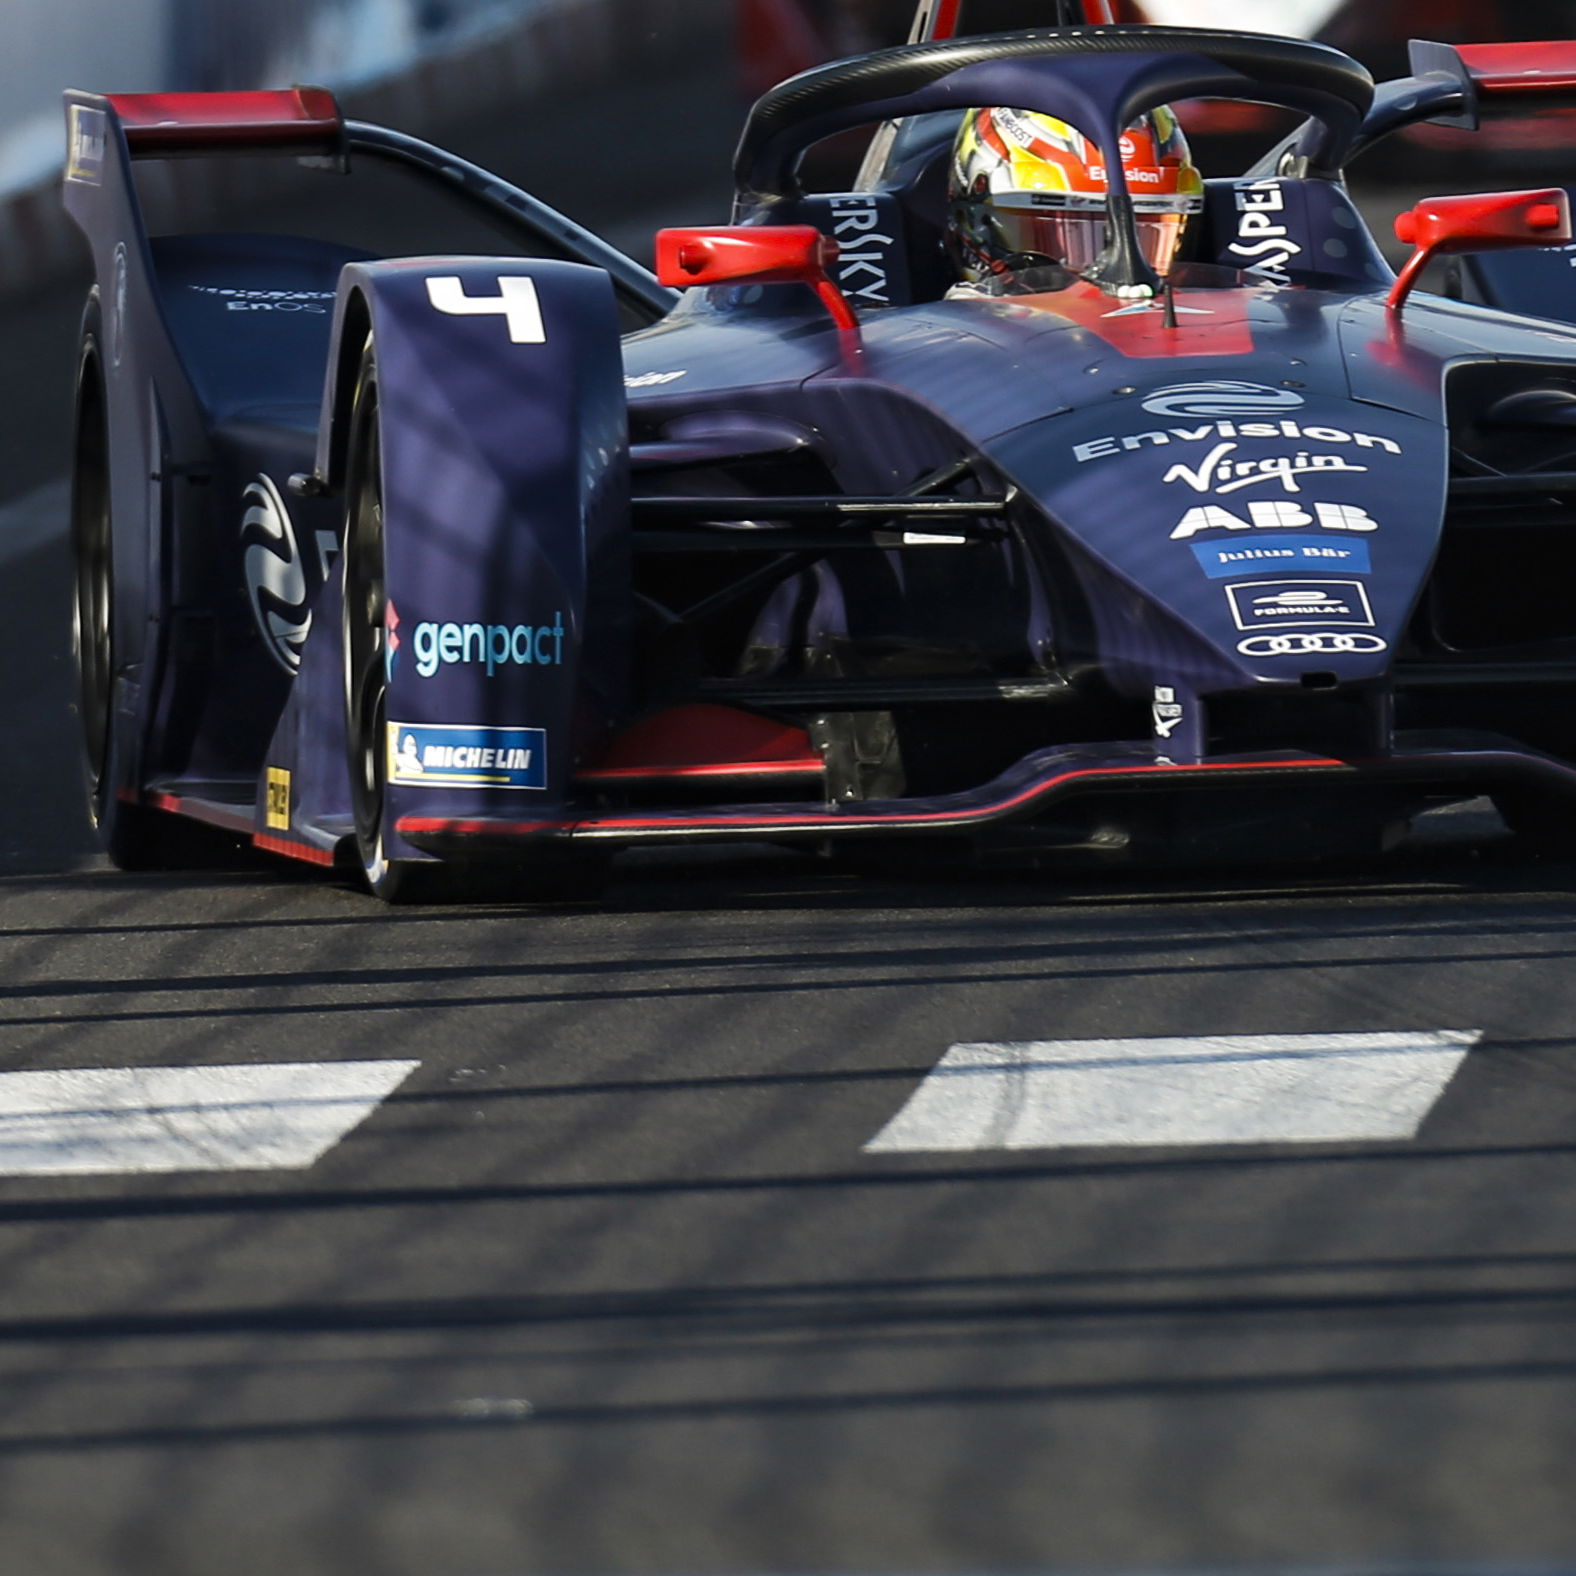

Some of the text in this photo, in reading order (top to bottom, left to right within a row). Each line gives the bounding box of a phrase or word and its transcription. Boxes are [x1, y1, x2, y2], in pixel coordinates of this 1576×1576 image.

[425, 276, 546, 343] 4
[1072, 420, 1402, 462] Envision
[1162, 442, 1368, 494] Virgin
[1168, 501, 1379, 540] ABB
[1218, 547, 1351, 563] Julius Bär
[413, 611, 564, 677] genpact
[423, 746, 532, 770] MICHELIN
